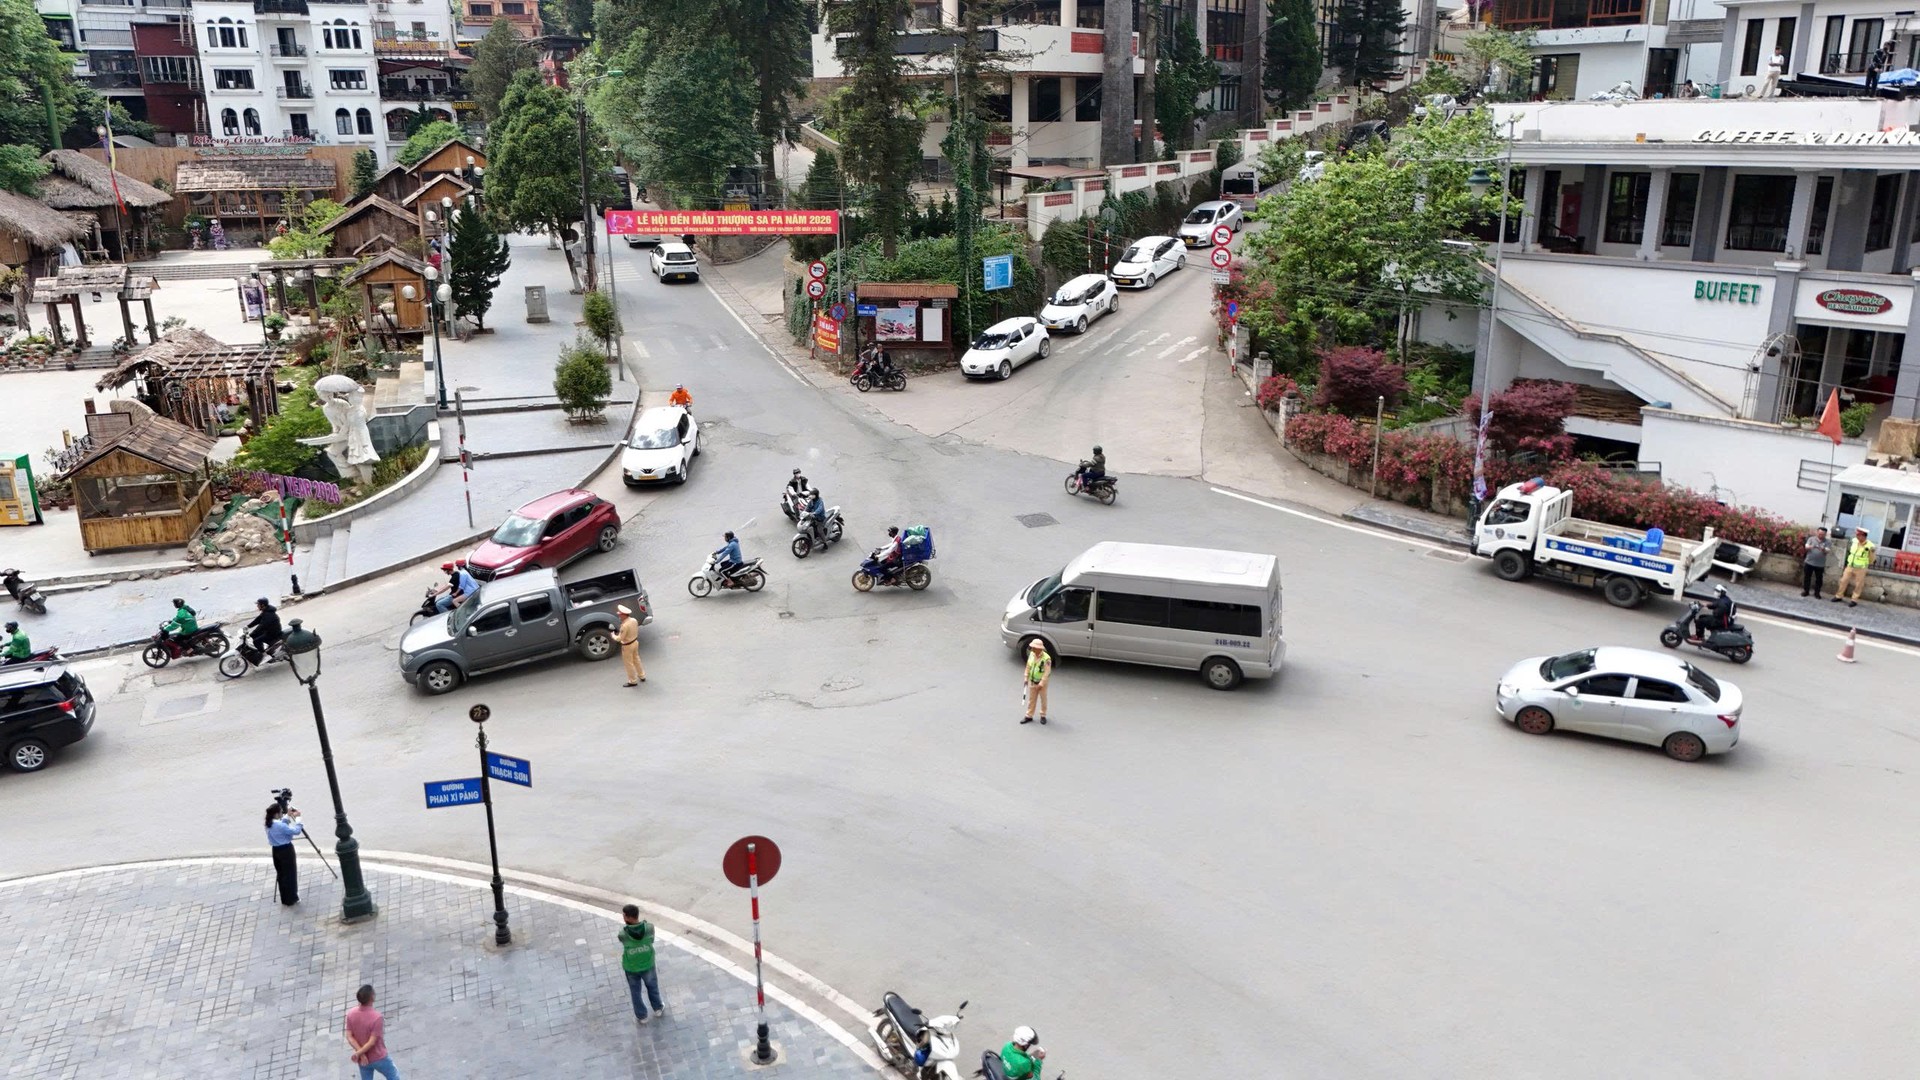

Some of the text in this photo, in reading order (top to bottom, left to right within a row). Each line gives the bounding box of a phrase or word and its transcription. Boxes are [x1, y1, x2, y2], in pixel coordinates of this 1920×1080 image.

[1691, 128, 1794, 143] COFFEE
[1797, 131, 1824, 145] &
[637, 212, 649, 225] LỄ
[651, 213, 668, 227] HỘI
[717, 214, 754, 227] THƯỢNG
[756, 215, 769, 225] SA
[771, 215, 783, 225] PA
[785, 213, 806, 225] NĂM
[809, 215, 832, 225] 2026
[1694, 280, 1760, 304] BUFFET
[1827, 303, 1880, 313] RESTAURANT
[284, 475, 312, 499] YEAR
[312, 479, 341, 505] 2026
[1592, 549, 1607, 558] SÁT
[1615, 555, 1633, 564] GIAO
[1640, 559, 1667, 570] THÔNG
[490, 765, 529, 783] THẠCH SƠN
[429, 794, 449, 804] PHAN
[629, 945, 650, 955] Grab
